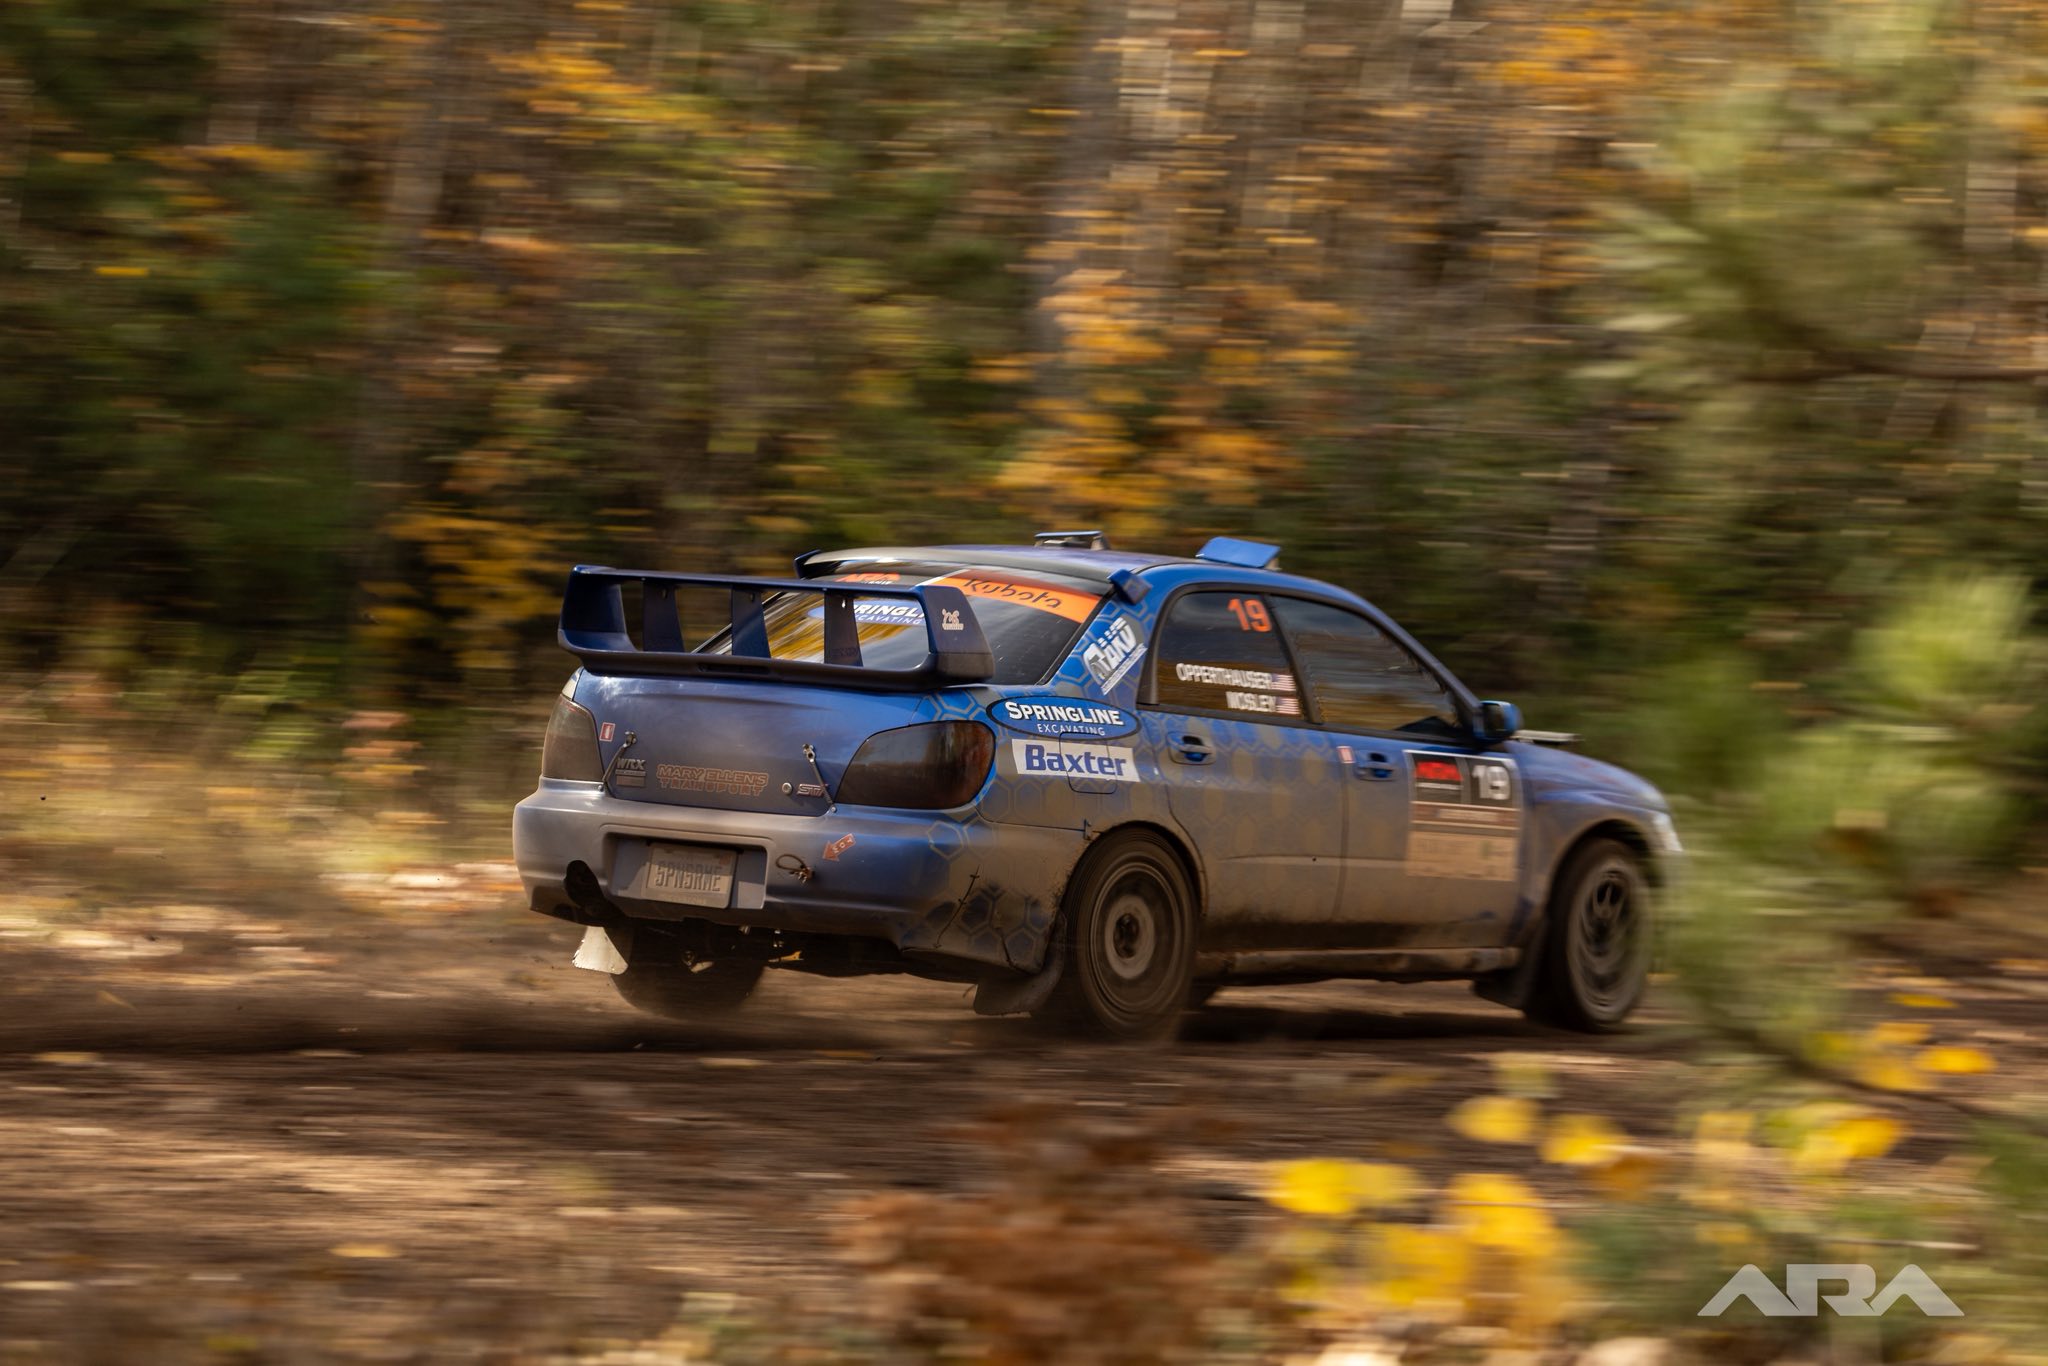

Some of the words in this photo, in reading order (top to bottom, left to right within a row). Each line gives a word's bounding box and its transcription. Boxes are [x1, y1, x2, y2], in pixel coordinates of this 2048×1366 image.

[964, 578, 1063, 609] Kubota
[1227, 598, 1272, 632] 19
[1005, 701, 1125, 726] SPRINGLINE
[1037, 723, 1106, 736] EXCAVATING
[616, 758, 647, 770] WRX
[657, 764, 704, 781] MARY
[1025, 744, 1127, 776] Baxter
[1472, 765, 1511, 800] 19
